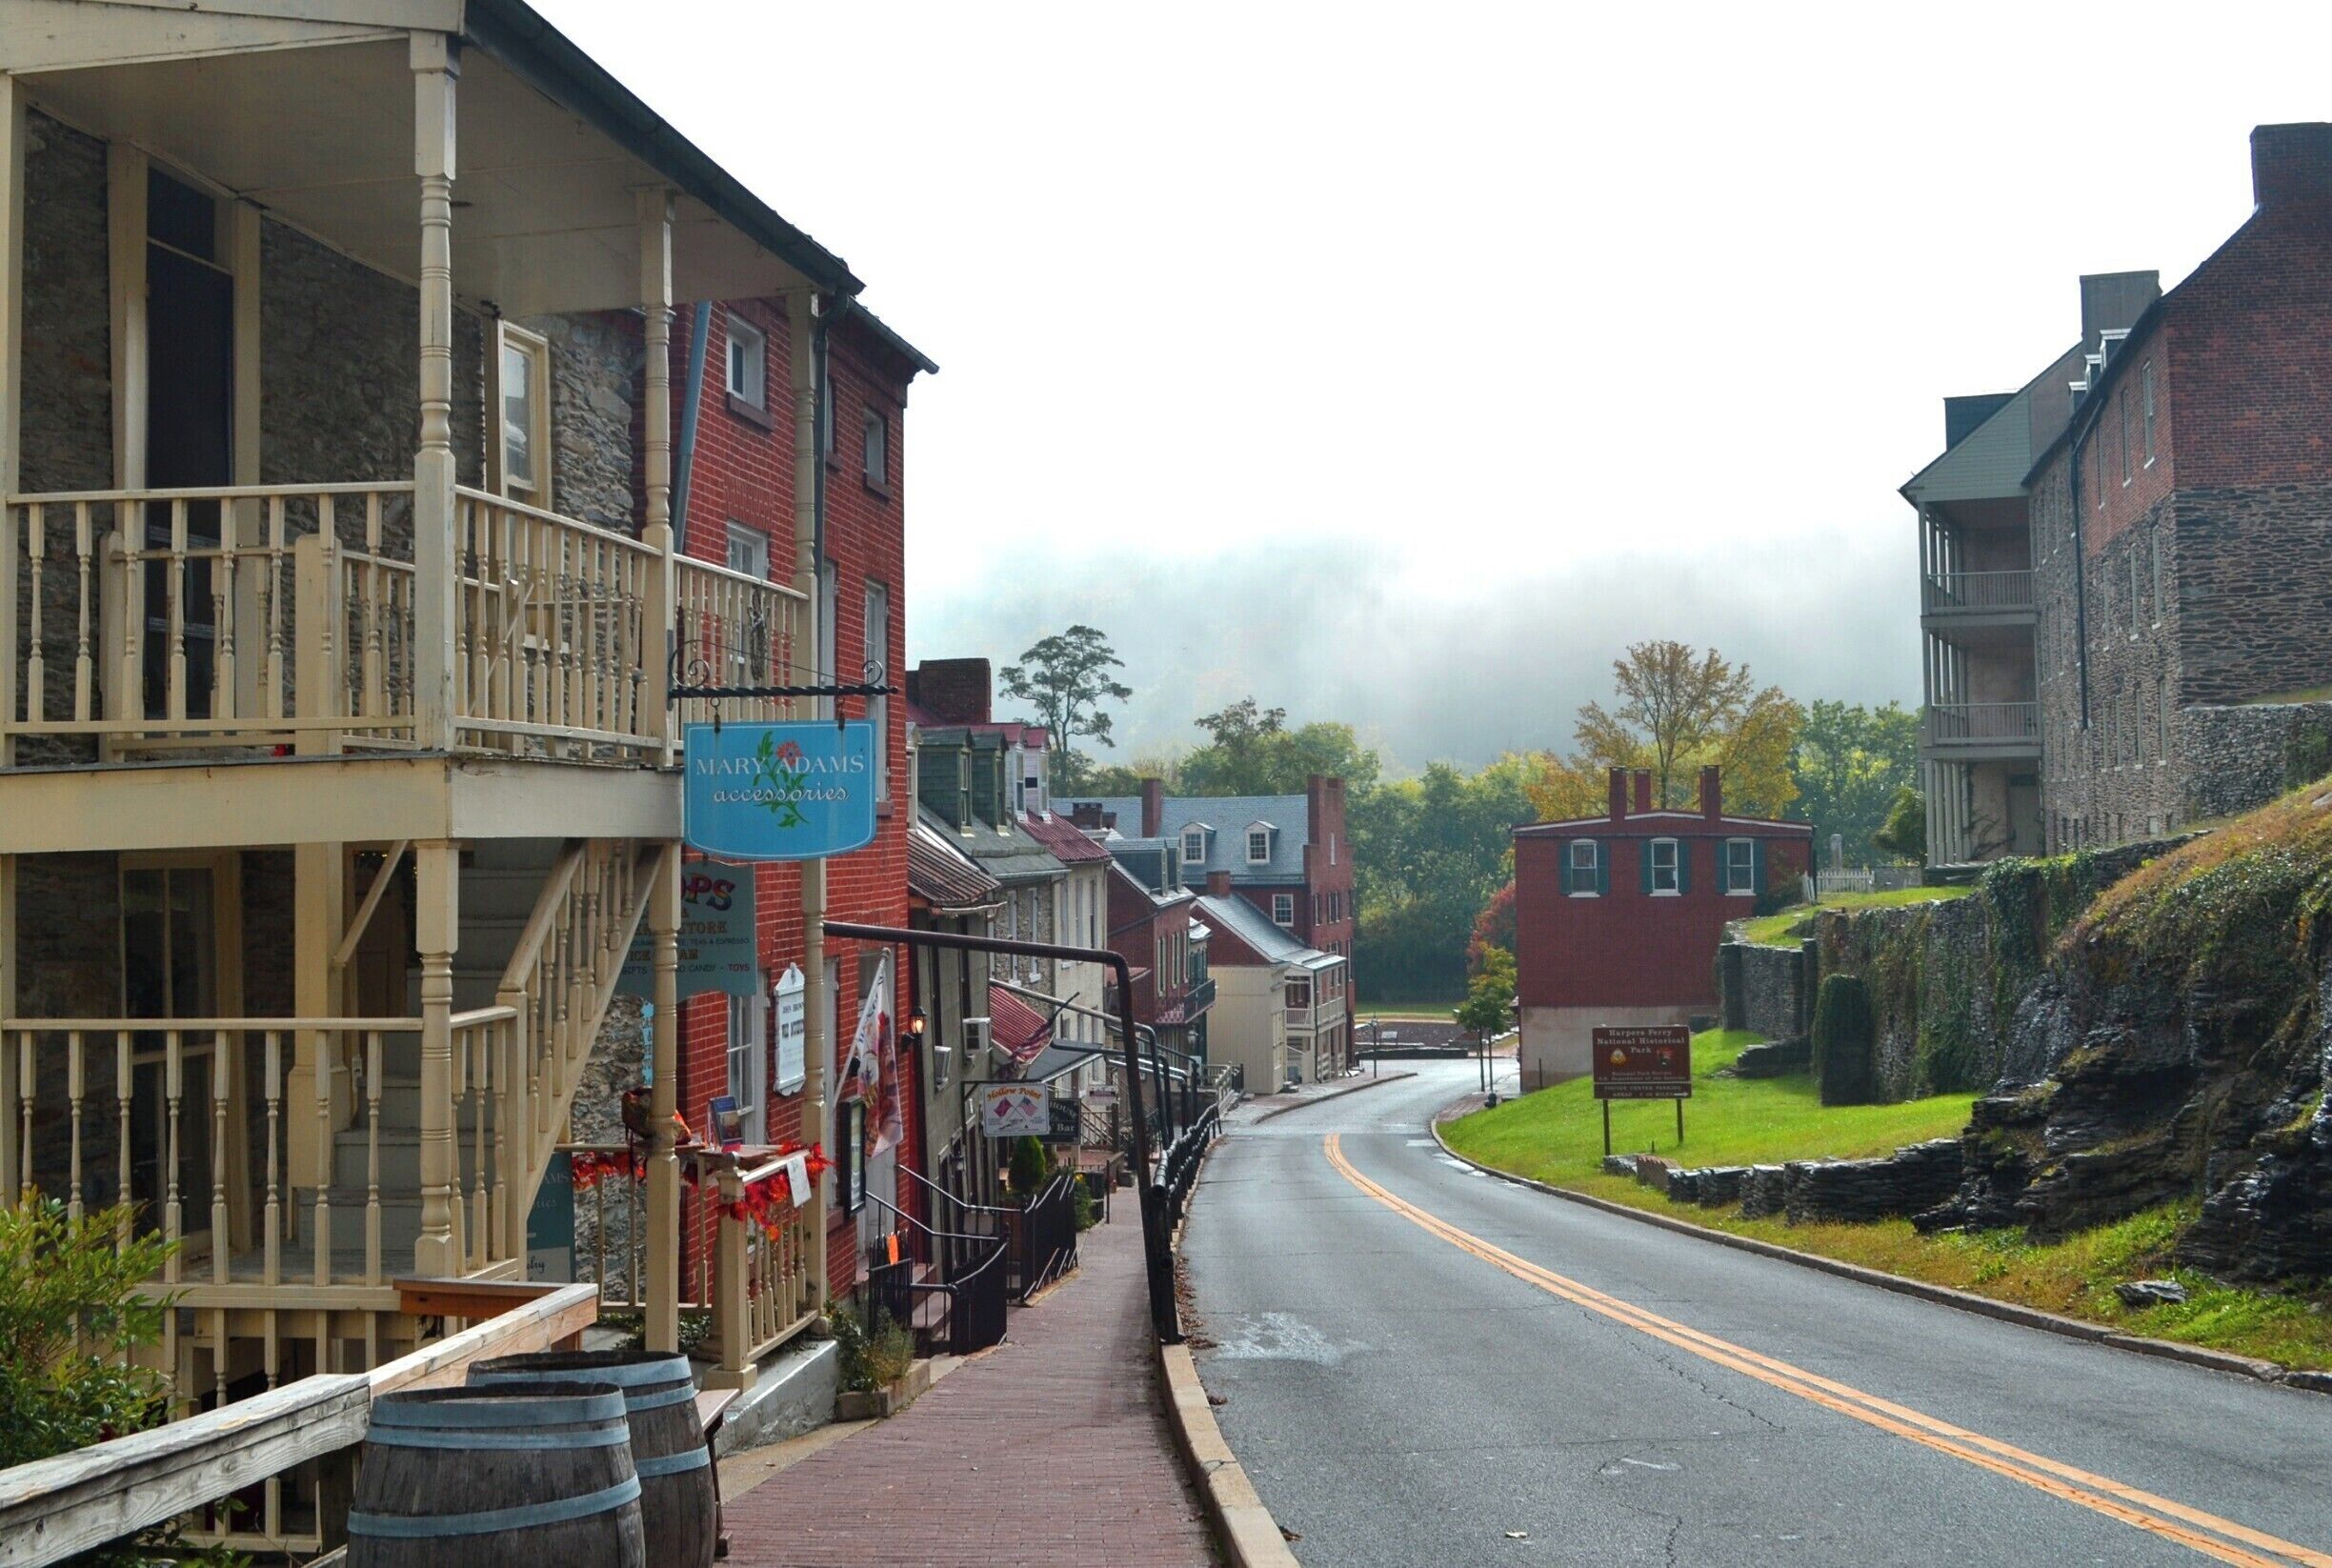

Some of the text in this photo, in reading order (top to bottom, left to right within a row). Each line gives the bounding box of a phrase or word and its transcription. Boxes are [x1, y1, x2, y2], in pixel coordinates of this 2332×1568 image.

[696, 754, 864, 775] MARY ADAMS
[714, 782, 849, 803] accessories
[688, 963, 716, 973] CANDY
[728, 963, 750, 972] TOYS
[1648, 1029, 1673, 1037] Ferry
[987, 1087, 1042, 1101] Hollow Point
[1056, 1123, 1075, 1132] Bar
